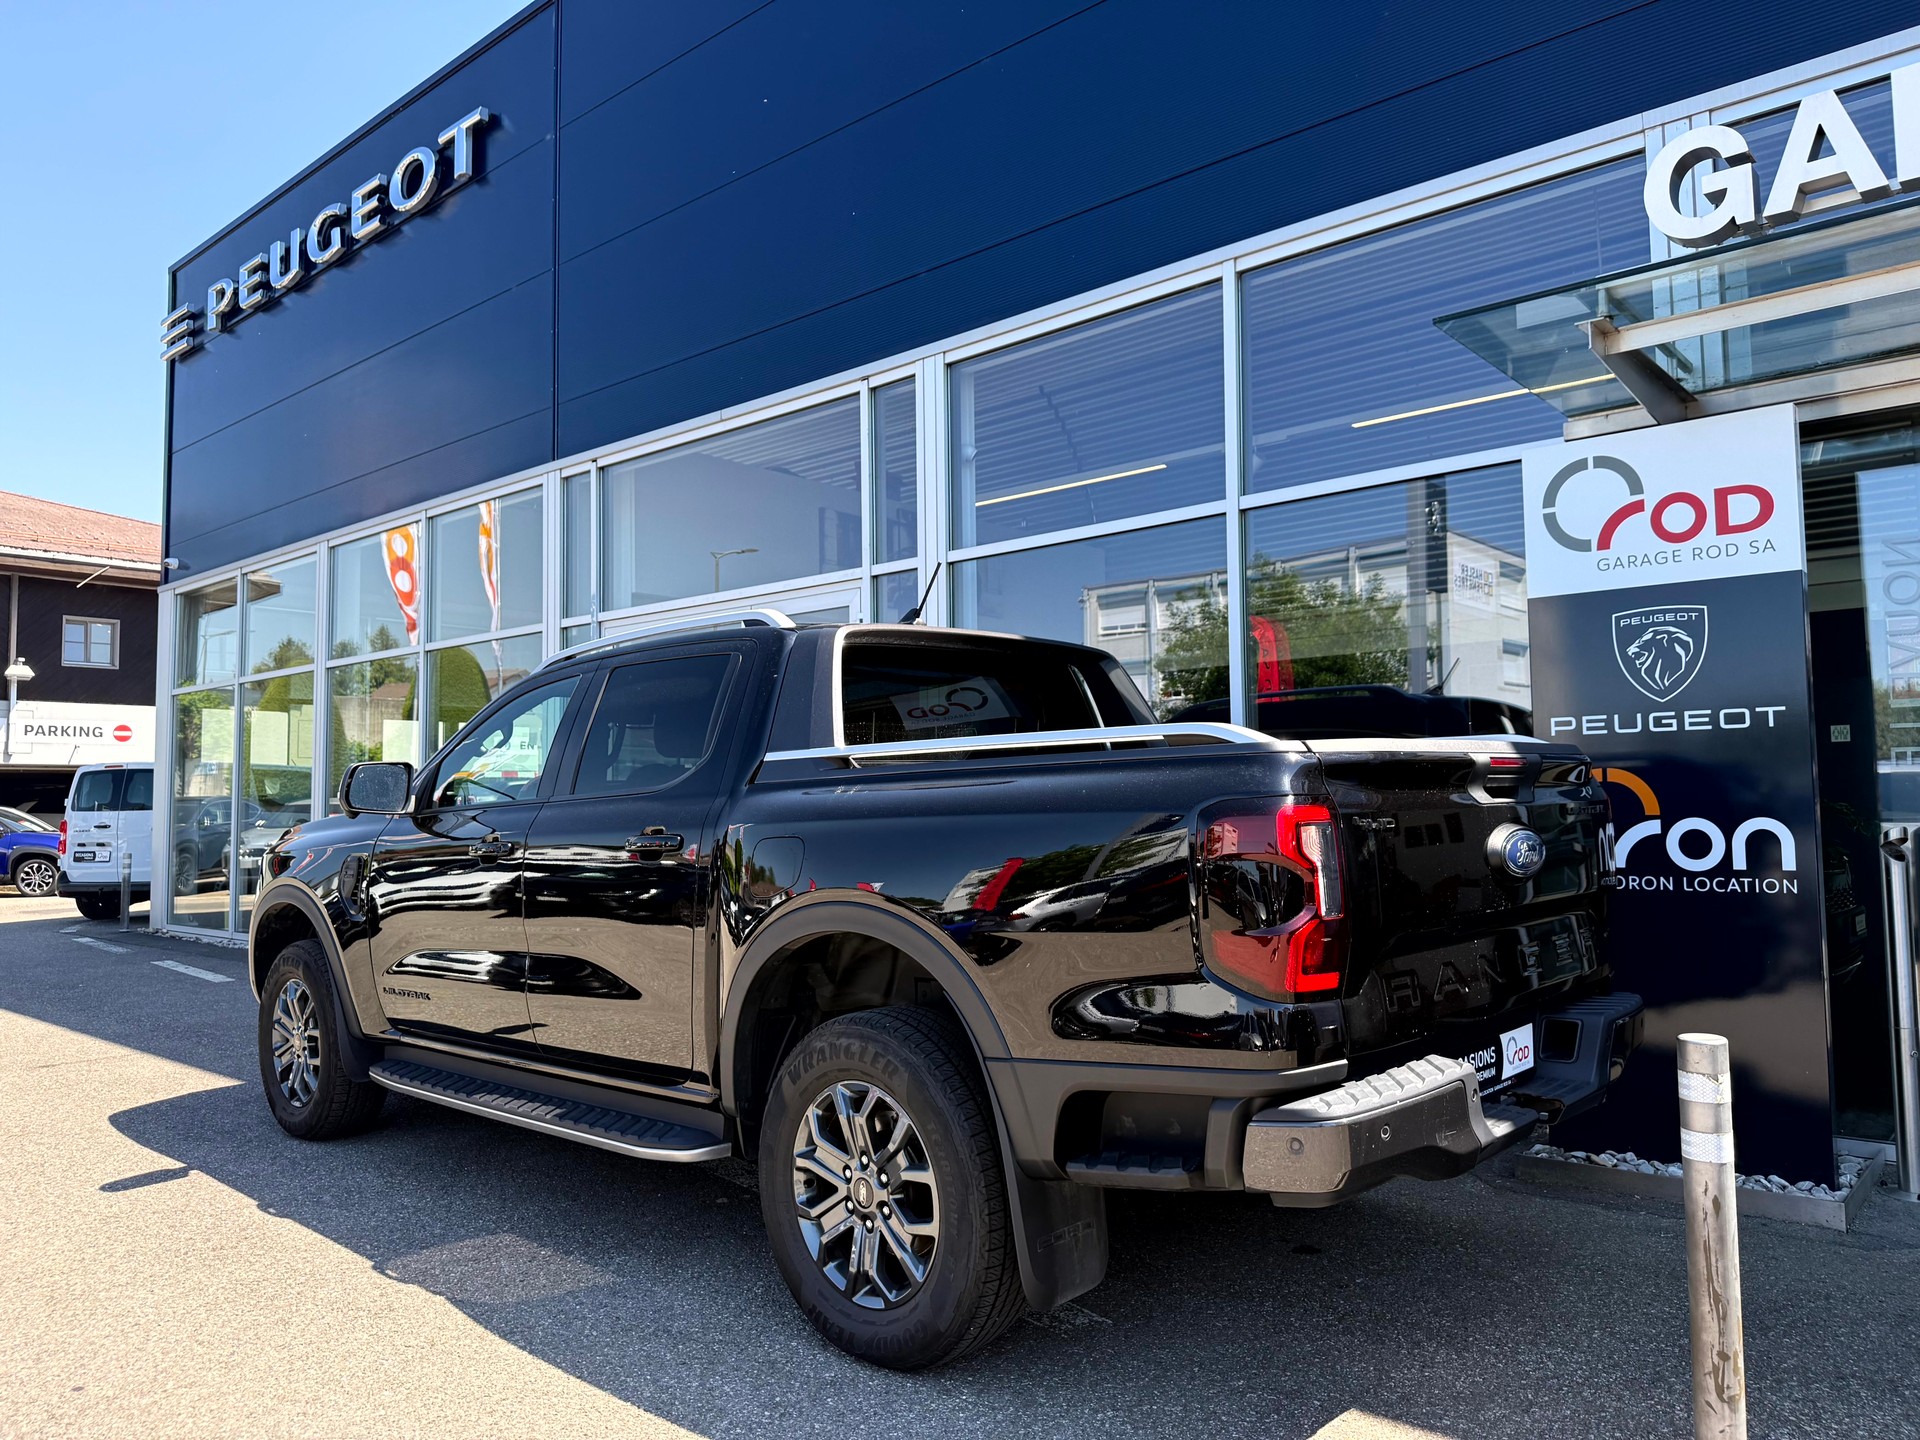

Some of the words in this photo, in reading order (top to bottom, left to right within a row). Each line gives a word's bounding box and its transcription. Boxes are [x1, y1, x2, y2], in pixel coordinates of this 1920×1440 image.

[207, 105, 489, 333] PEUGEOT
[1596, 548, 1683, 572] GARAGE
[1692, 542, 1739, 561] ROD
[1749, 538, 1777, 555] SA
[1620, 612, 1699, 627] PEUGEOT
[24, 724, 104, 738] PARKING
[1550, 705, 1787, 737] PEUGEOT
[1683, 876, 1798, 895] LOCATION
[787, 1041, 899, 1086] WRANGLER
[1458, 1046, 1496, 1069] SIONS
